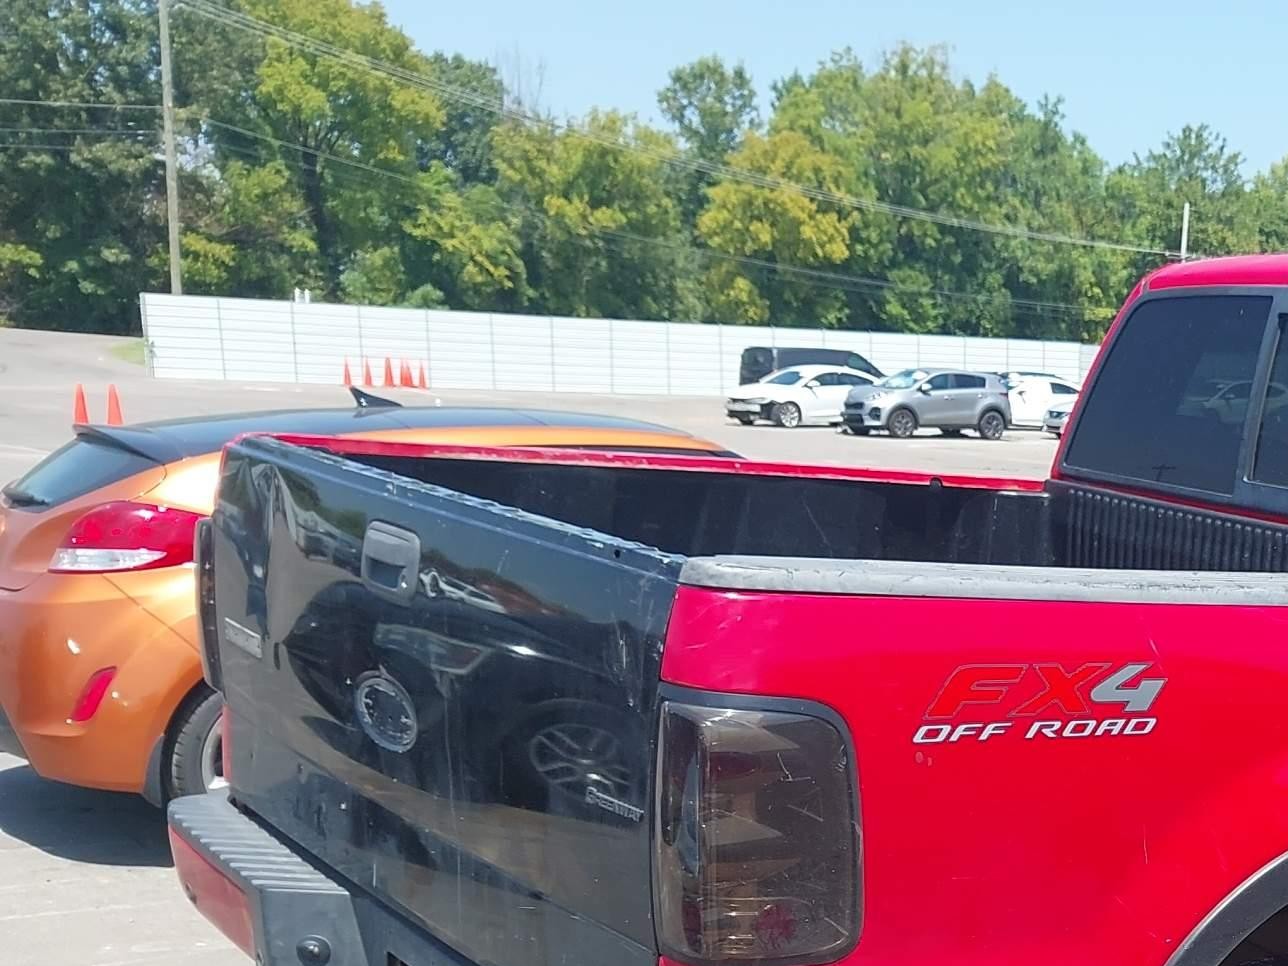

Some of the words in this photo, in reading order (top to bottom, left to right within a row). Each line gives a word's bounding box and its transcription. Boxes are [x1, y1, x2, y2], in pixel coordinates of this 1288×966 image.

[923, 662, 1168, 720] FX4
[912, 720, 1013, 744] OFF
[1024, 717, 1157, 739] ROAD
